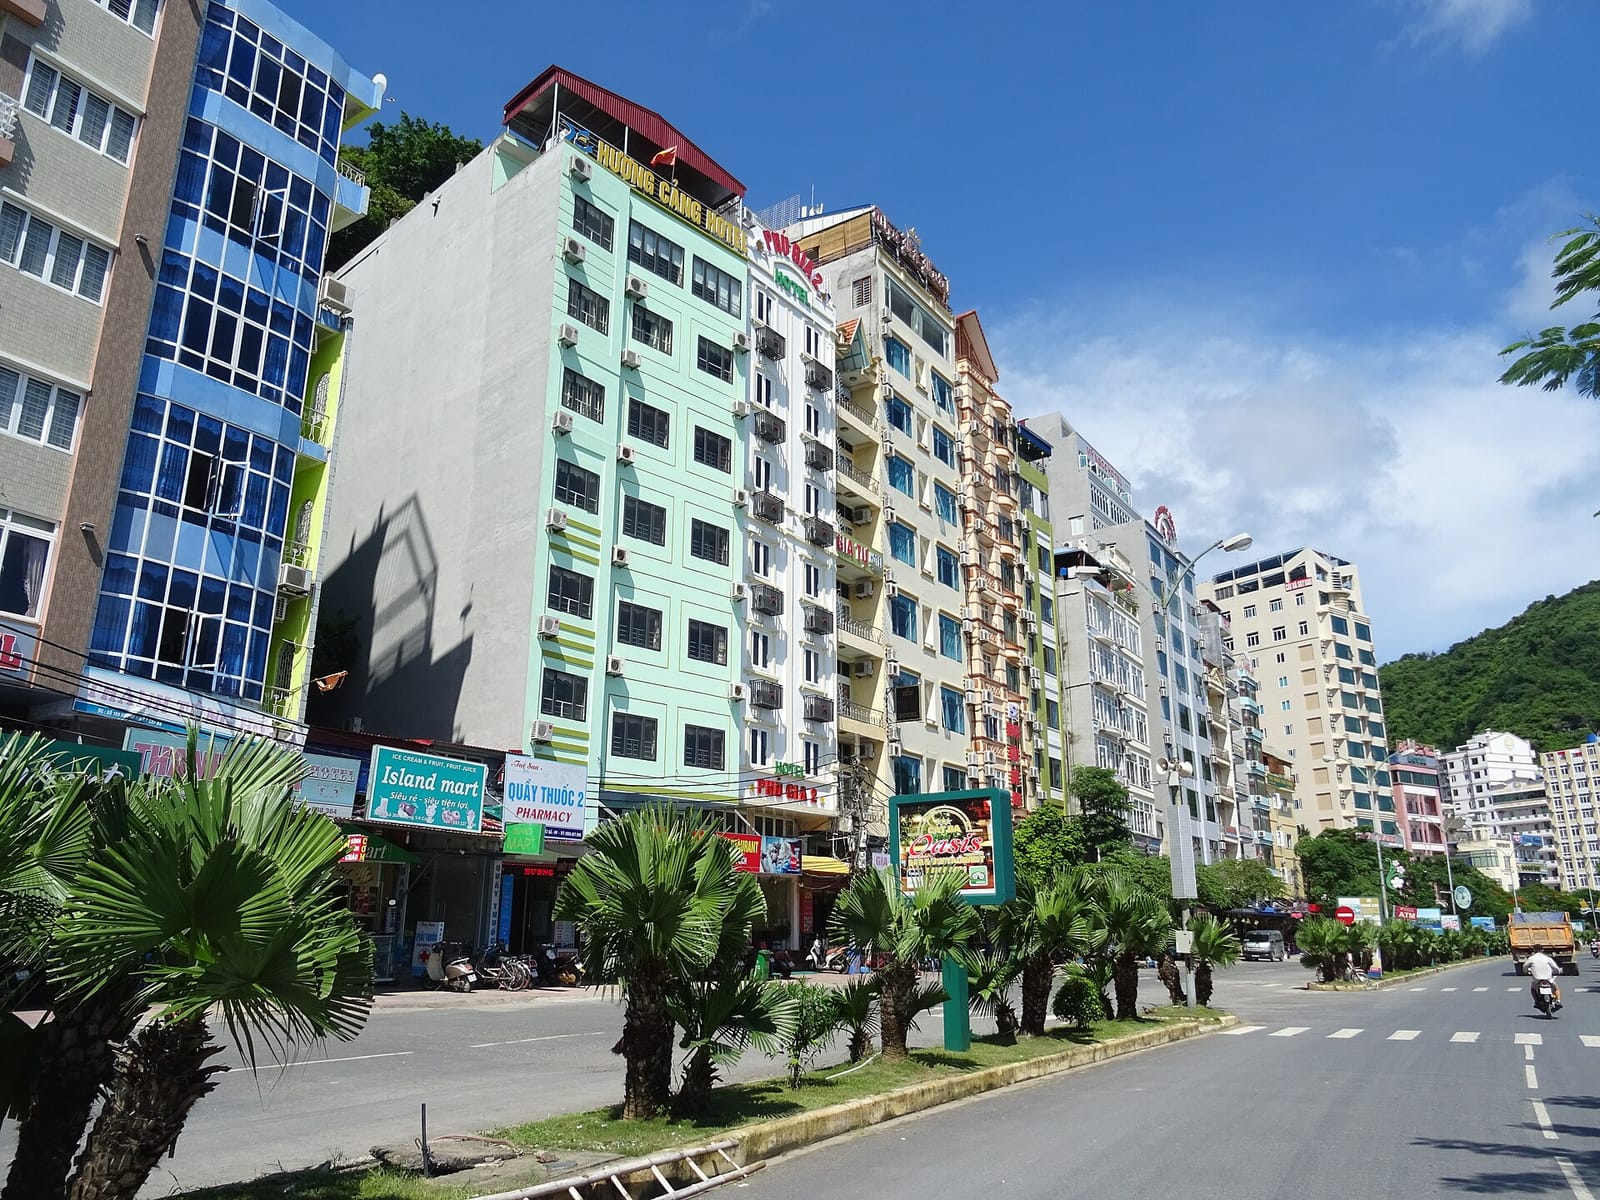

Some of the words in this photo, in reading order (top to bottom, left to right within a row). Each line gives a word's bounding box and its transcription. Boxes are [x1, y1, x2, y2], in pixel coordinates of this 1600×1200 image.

[659, 179, 702, 225] CẢNG
[705, 209, 748, 254] HOTEL
[775, 268, 811, 307] HOTEL
[811, 273, 823, 291] 2
[403, 755, 423, 763] CREAM
[775, 760, 805, 778] HOTEL
[381, 765, 437, 791] Island
[440, 779, 479, 797] mart
[390, 791, 408, 801] Siêu
[423, 796, 440, 805] siêu
[508, 778, 538, 802] QUẦY
[541, 783, 575, 807] THUỐC
[576, 791, 584, 808] 2
[785, 783, 808, 801] GIA
[810, 787, 818, 803] 2
[516, 806, 573, 823] PHARMACY
[908, 833, 984, 857] Oasis
[1398, 911, 1416, 919] ATM
